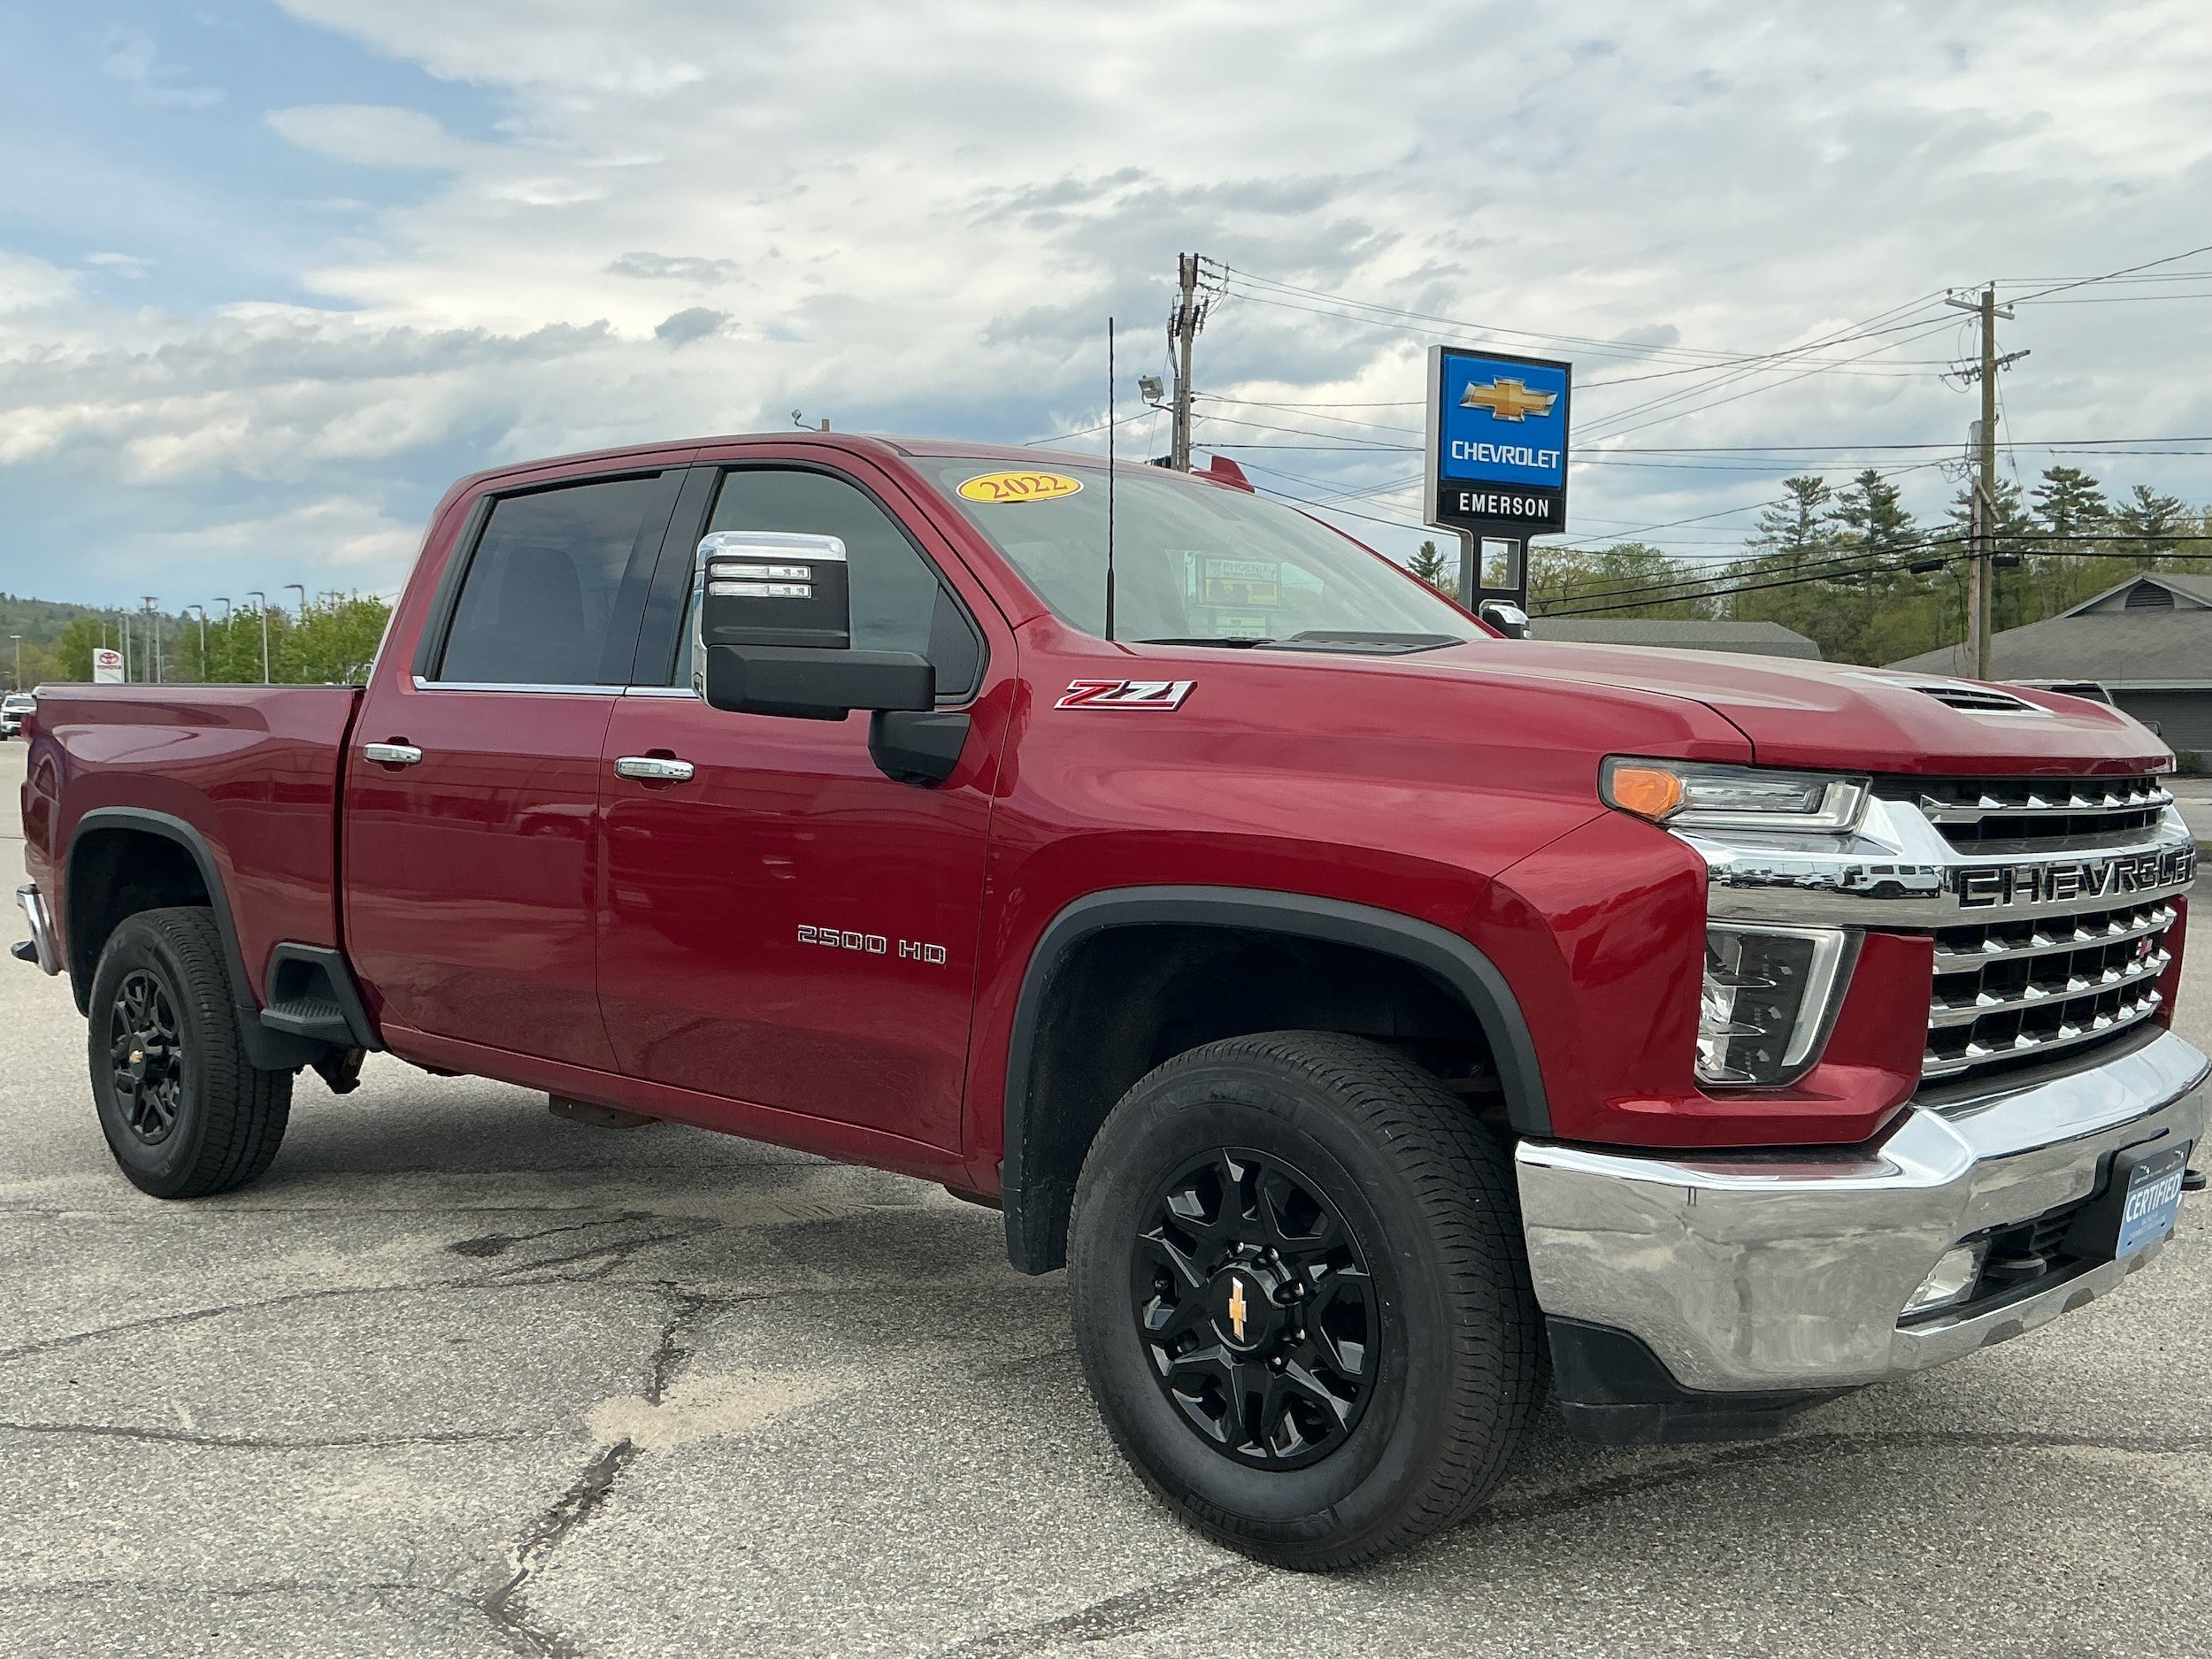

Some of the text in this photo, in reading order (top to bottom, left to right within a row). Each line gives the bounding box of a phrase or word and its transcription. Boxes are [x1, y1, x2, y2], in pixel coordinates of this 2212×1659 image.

[1451, 441, 1560, 469] CHEVROLET
[979, 475, 1068, 499] 2022
[1459, 493, 1548, 518] EMERSON
[1223, 562, 1269, 572] PHOENIX
[1053, 679, 1198, 711] Z71
[1959, 851, 2196, 910] CHEVROLET
[797, 925, 946, 964] 2500 HD
[2125, 1172, 2181, 1223] CERTIFIED
